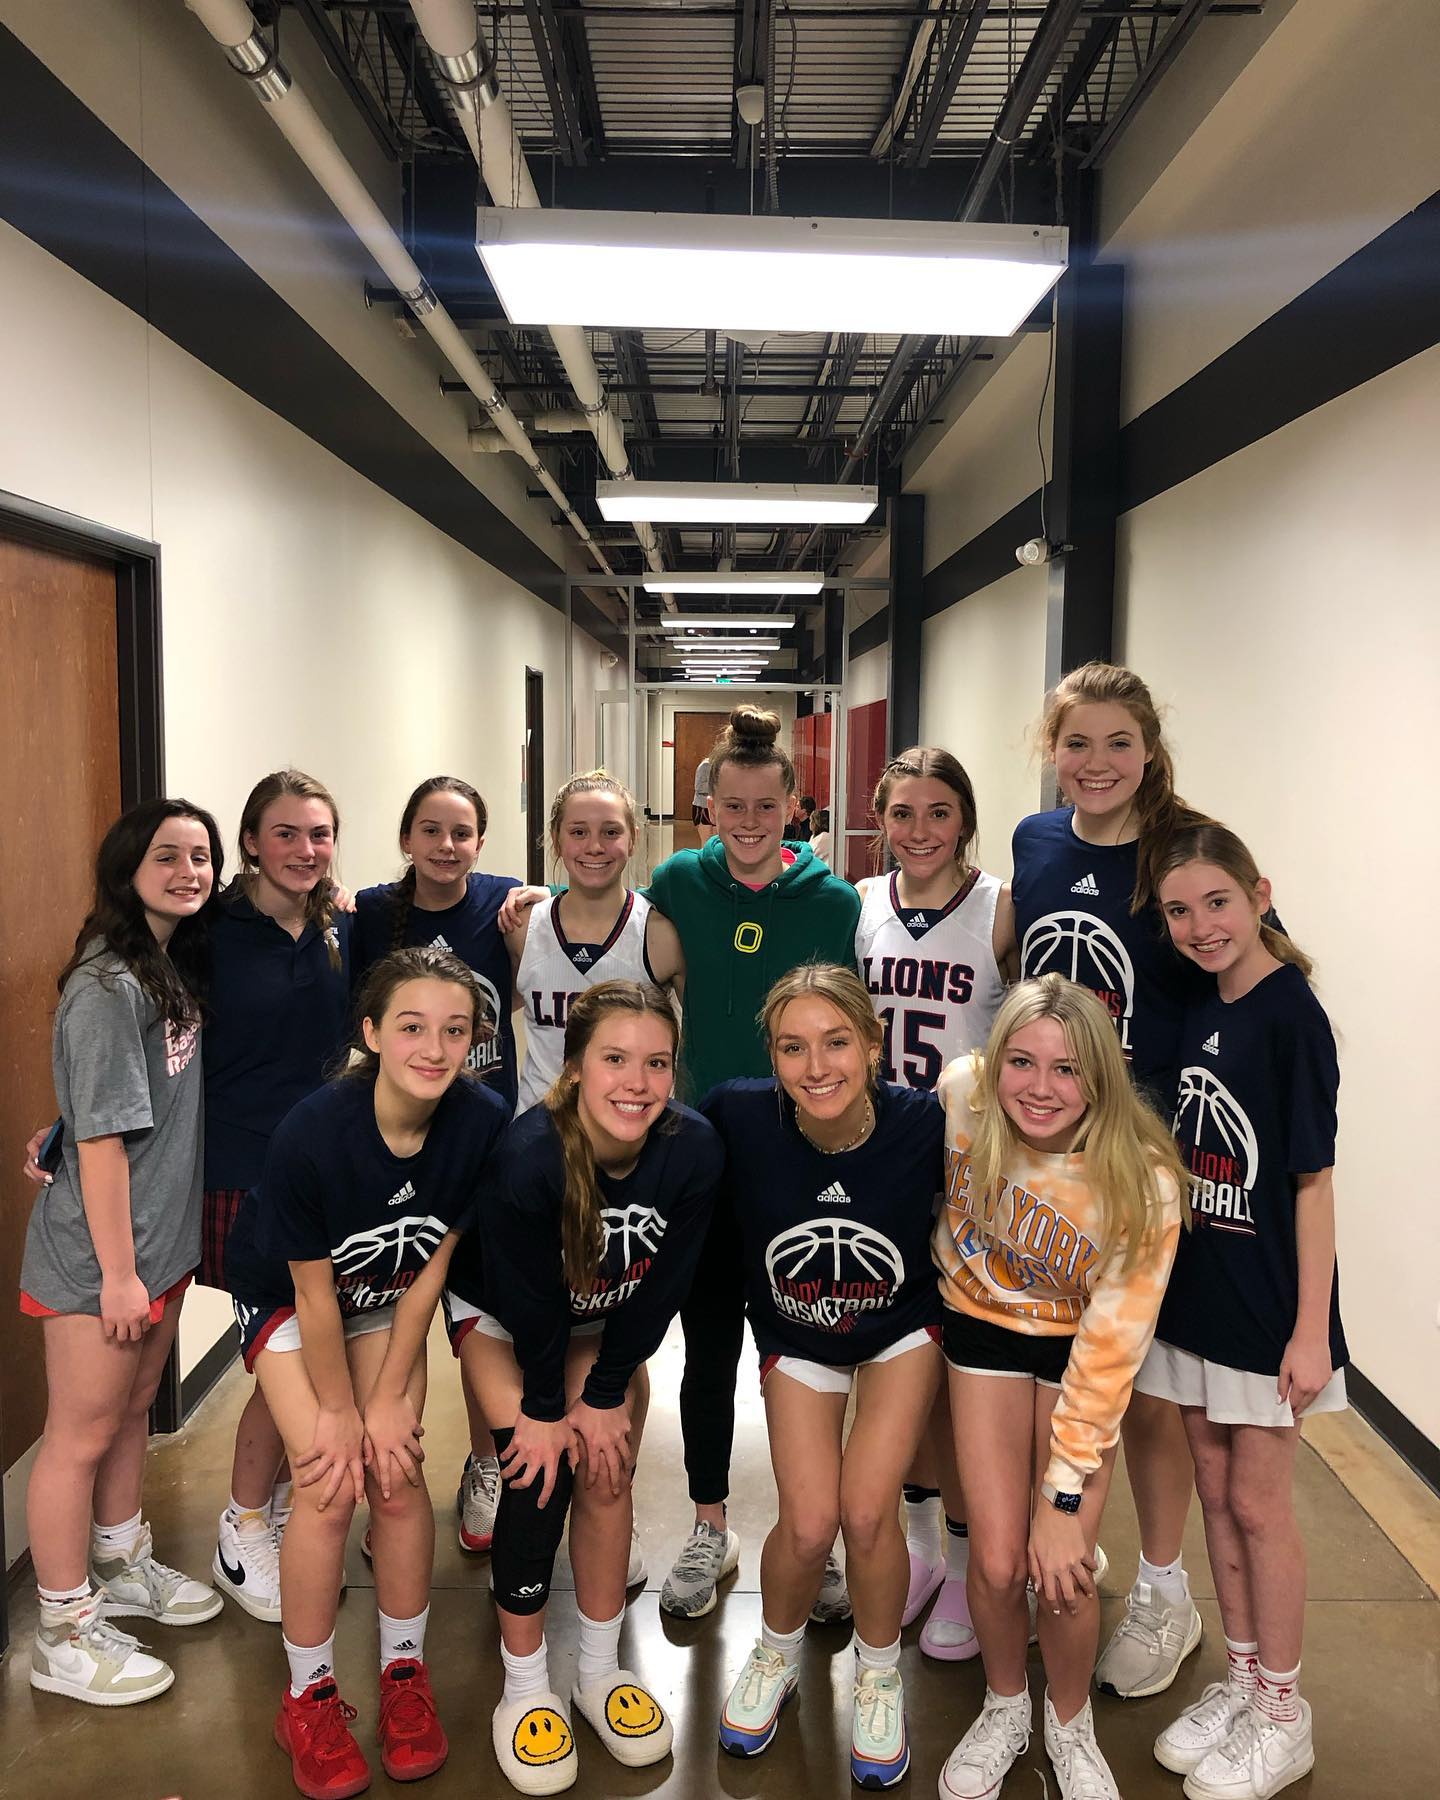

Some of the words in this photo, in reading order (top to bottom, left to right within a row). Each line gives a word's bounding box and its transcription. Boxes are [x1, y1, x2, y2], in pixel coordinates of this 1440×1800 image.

[1070, 885, 1100, 897] adidas
[863, 956, 975, 1005] LIONS
[878, 1007, 946, 1090] 15
[816, 1194, 851, 1204] adidas
[1008, 1185, 1100, 1297] YORK
[778, 1275, 823, 1304] LADY
[831, 1280, 889, 1298] LIONS
